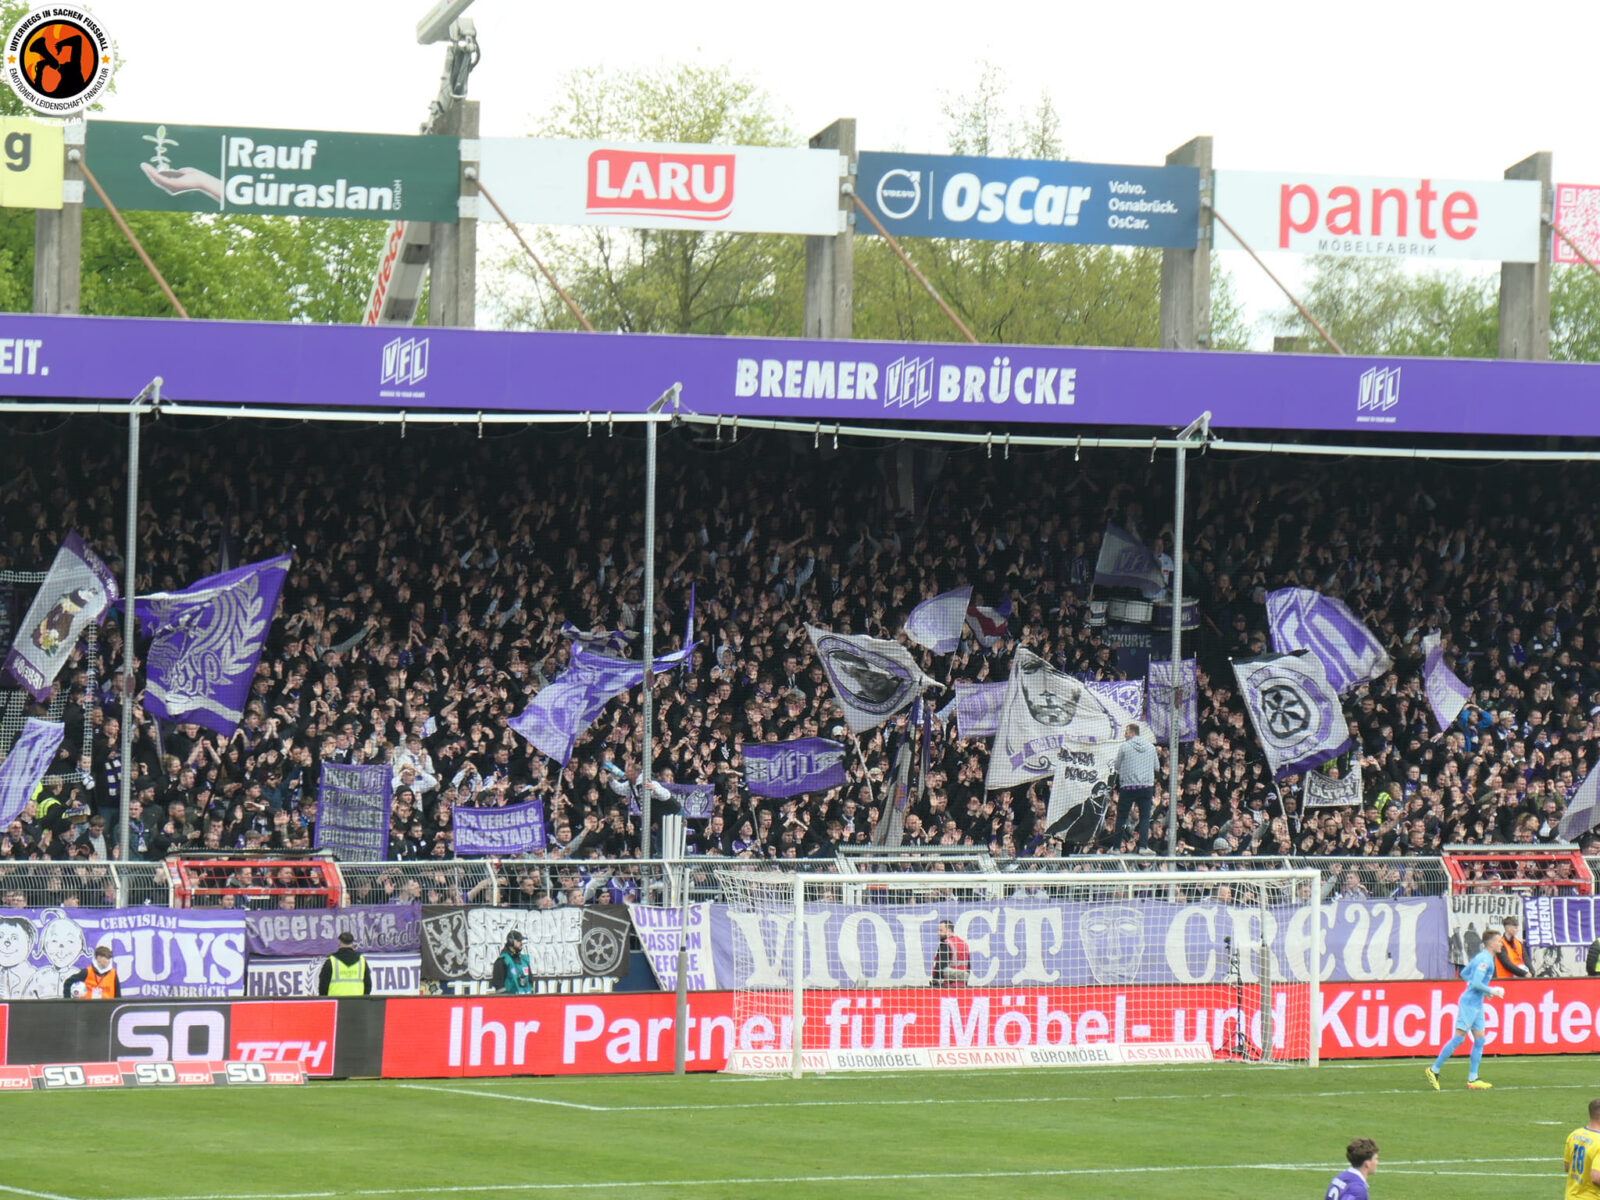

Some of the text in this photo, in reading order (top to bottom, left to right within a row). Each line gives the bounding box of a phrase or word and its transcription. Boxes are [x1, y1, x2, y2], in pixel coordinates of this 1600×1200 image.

[4, 131, 32, 173] g
[227, 136, 318, 170] Rauf
[225, 174, 403, 210] Güraslan GmbH
[594, 160, 727, 204] LARU
[1108, 180, 1147, 195] Volvo.
[1108, 198, 1178, 214] Osnabrück.
[1278, 179, 1479, 249] pante
[1108, 215, 1149, 230] OsCar.
[1318, 239, 1438, 256] MÖBELFABRIK
[735, 358, 879, 400] BREMER
[938, 356, 1076, 406] BRÜCKE
[456, 824, 542, 848] HASESTADT
[100, 914, 178, 930] CERVISIAM
[1526, 898, 1541, 946] ULTRA
[1538, 896, 1554, 946] JUGEND
[95, 929, 246, 985] GUYS
[726, 902, 1428, 988] VIOLET CREW
[649, 954, 699, 973] EFOE
[141, 984, 227, 998] OSNABRÜCK
[250, 970, 304, 996] HASE
[117, 1010, 327, 1068] SO TECH
[448, 989, 1600, 1067] Ihr Partner für Möbel- und Küchente
[225, 1062, 302, 1082] SO TECH
[741, 1046, 1207, 1069] ASSMNN BÜROMÖBEL ASSMANN BÜROMÖBEL ASSMANN
[42, 1066, 120, 1086] SO TECH
[134, 1063, 211, 1083] SO TECH
[1571, 1143, 1586, 1175] 18
